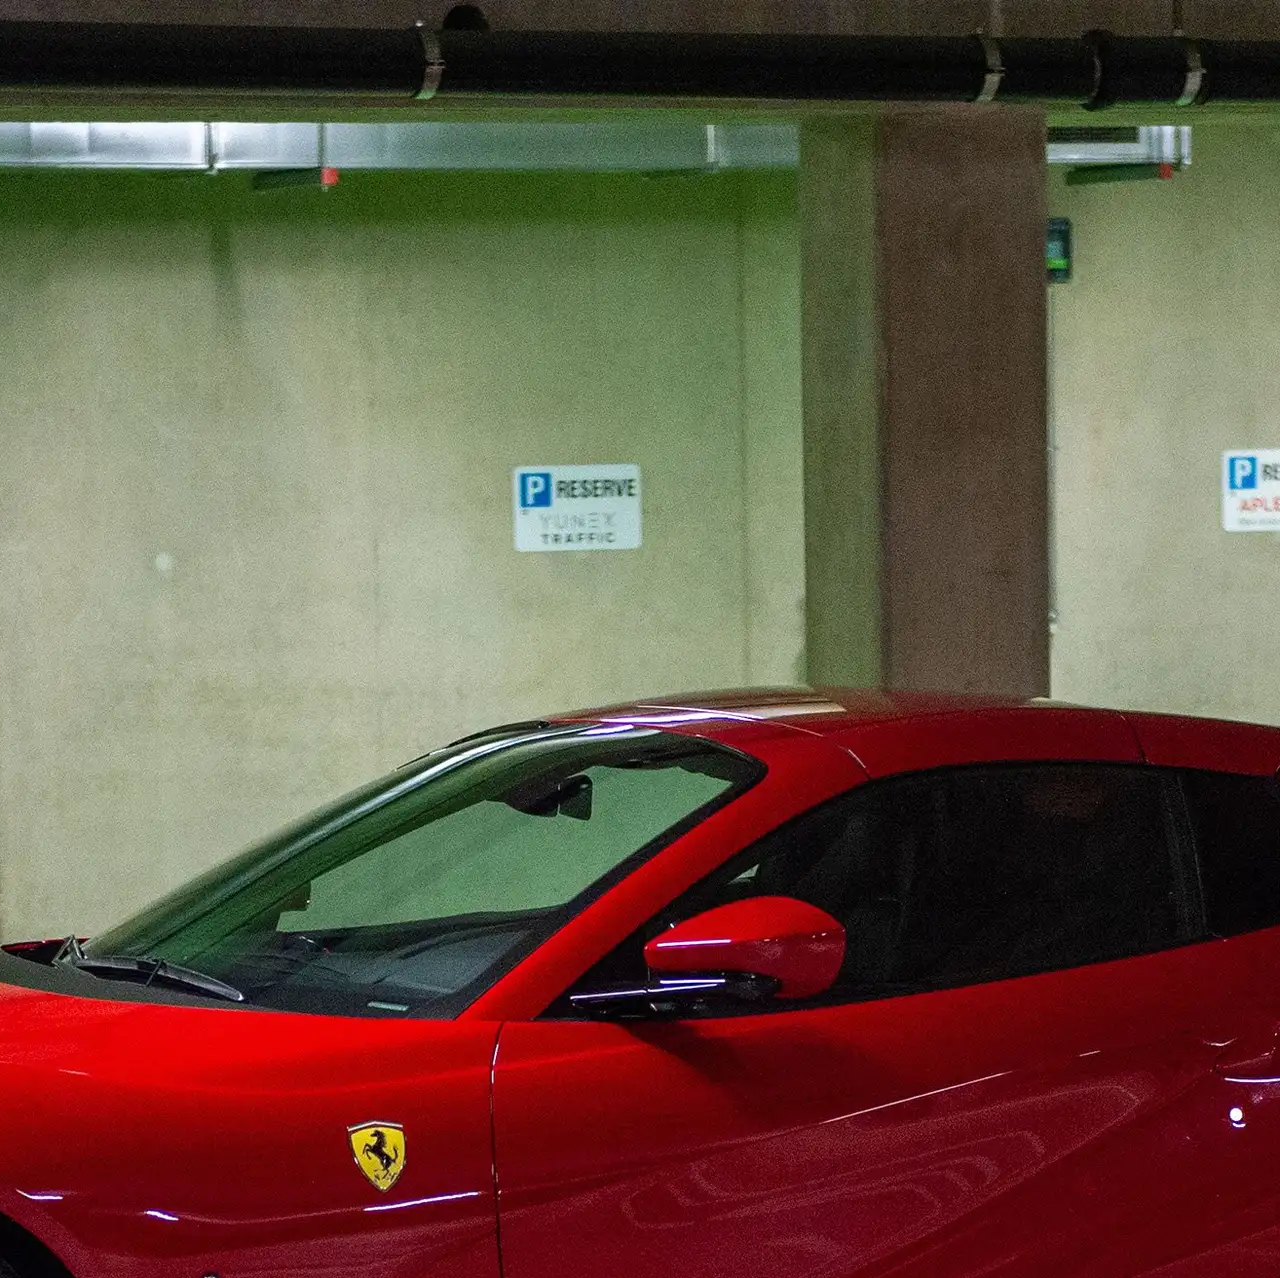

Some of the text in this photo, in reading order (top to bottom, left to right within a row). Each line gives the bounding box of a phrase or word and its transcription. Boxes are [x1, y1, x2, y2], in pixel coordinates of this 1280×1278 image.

[1234, 458, 1252, 488] P
[526, 475, 637, 505] P RESERVE
[539, 512, 616, 529] YUNEX
[541, 532, 616, 544] TRAFFIC
